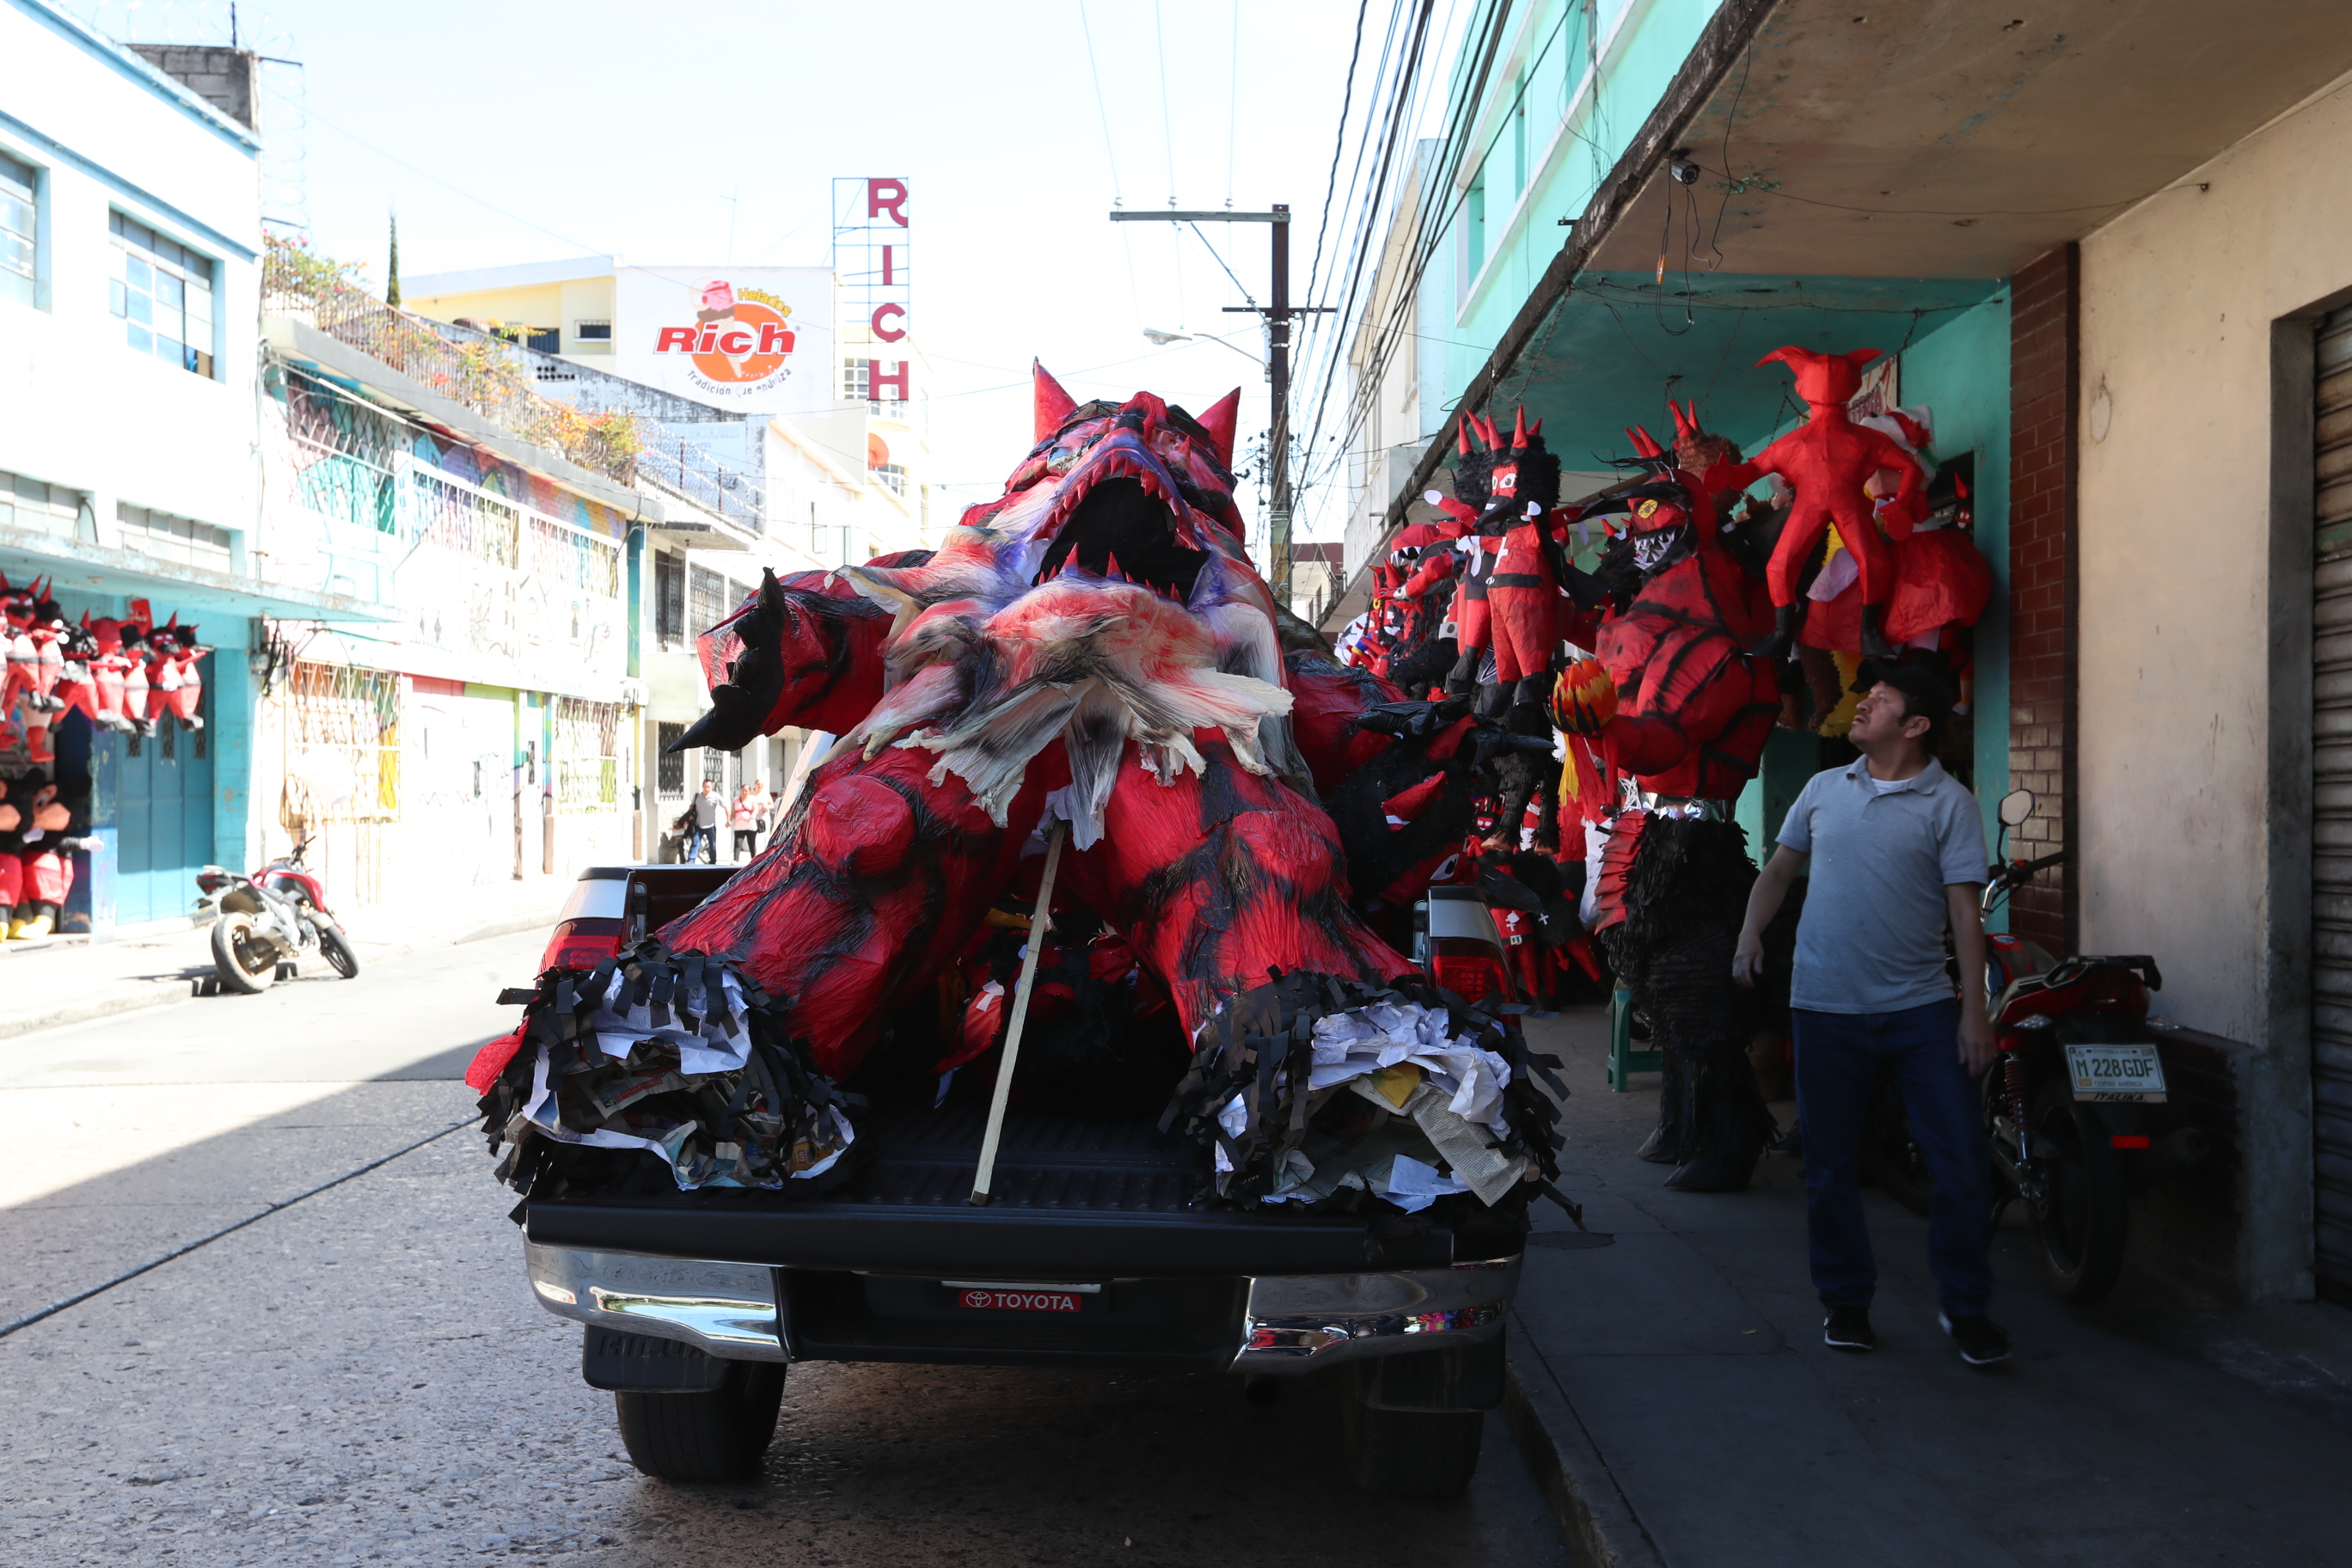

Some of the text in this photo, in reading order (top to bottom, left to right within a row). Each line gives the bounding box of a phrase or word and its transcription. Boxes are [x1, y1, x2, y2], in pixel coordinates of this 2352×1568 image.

[738, 287, 792, 317] Helados
[868, 178, 909, 401] RICH
[653, 323, 796, 356] Rich
[687, 370, 731, 395] Tradición
[735, 384, 753, 398] ue
[2075, 1058, 2154, 1077] M 228GDF
[2093, 1092, 2144, 1101] ITALIKA
[995, 1293, 1075, 1310] TOYOTA
